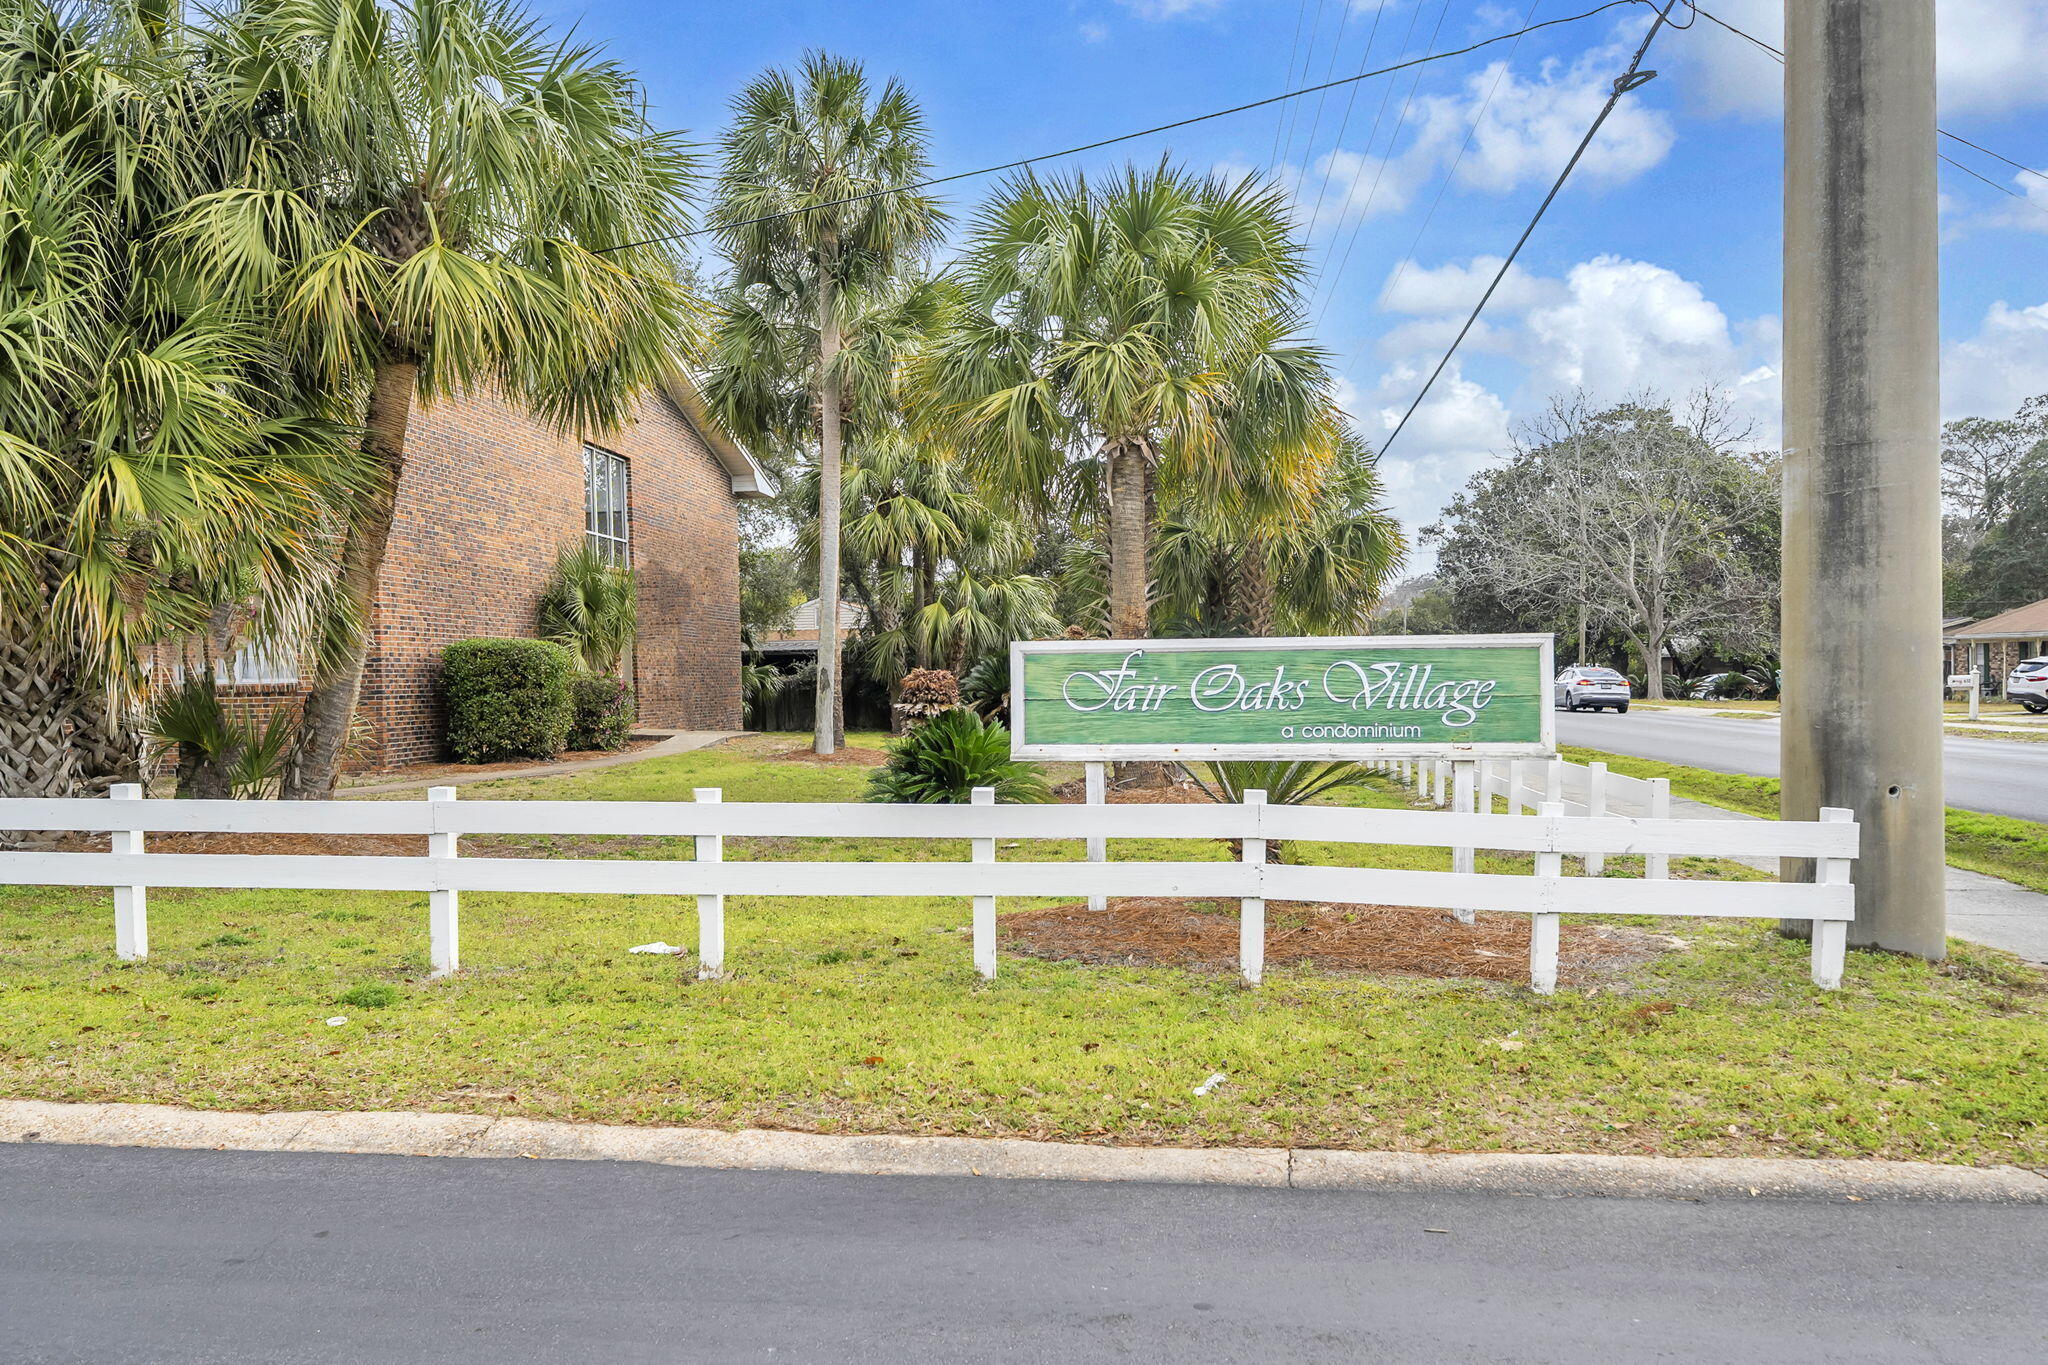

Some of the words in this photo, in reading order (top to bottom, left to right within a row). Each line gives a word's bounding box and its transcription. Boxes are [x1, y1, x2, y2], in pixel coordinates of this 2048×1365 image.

[1063, 649, 1178, 712] Fair
[1190, 664, 1309, 712] Oaks
[1323, 660, 1496, 727] Village
[1281, 726, 1294, 738] a
[1302, 723, 1421, 738] condominium
